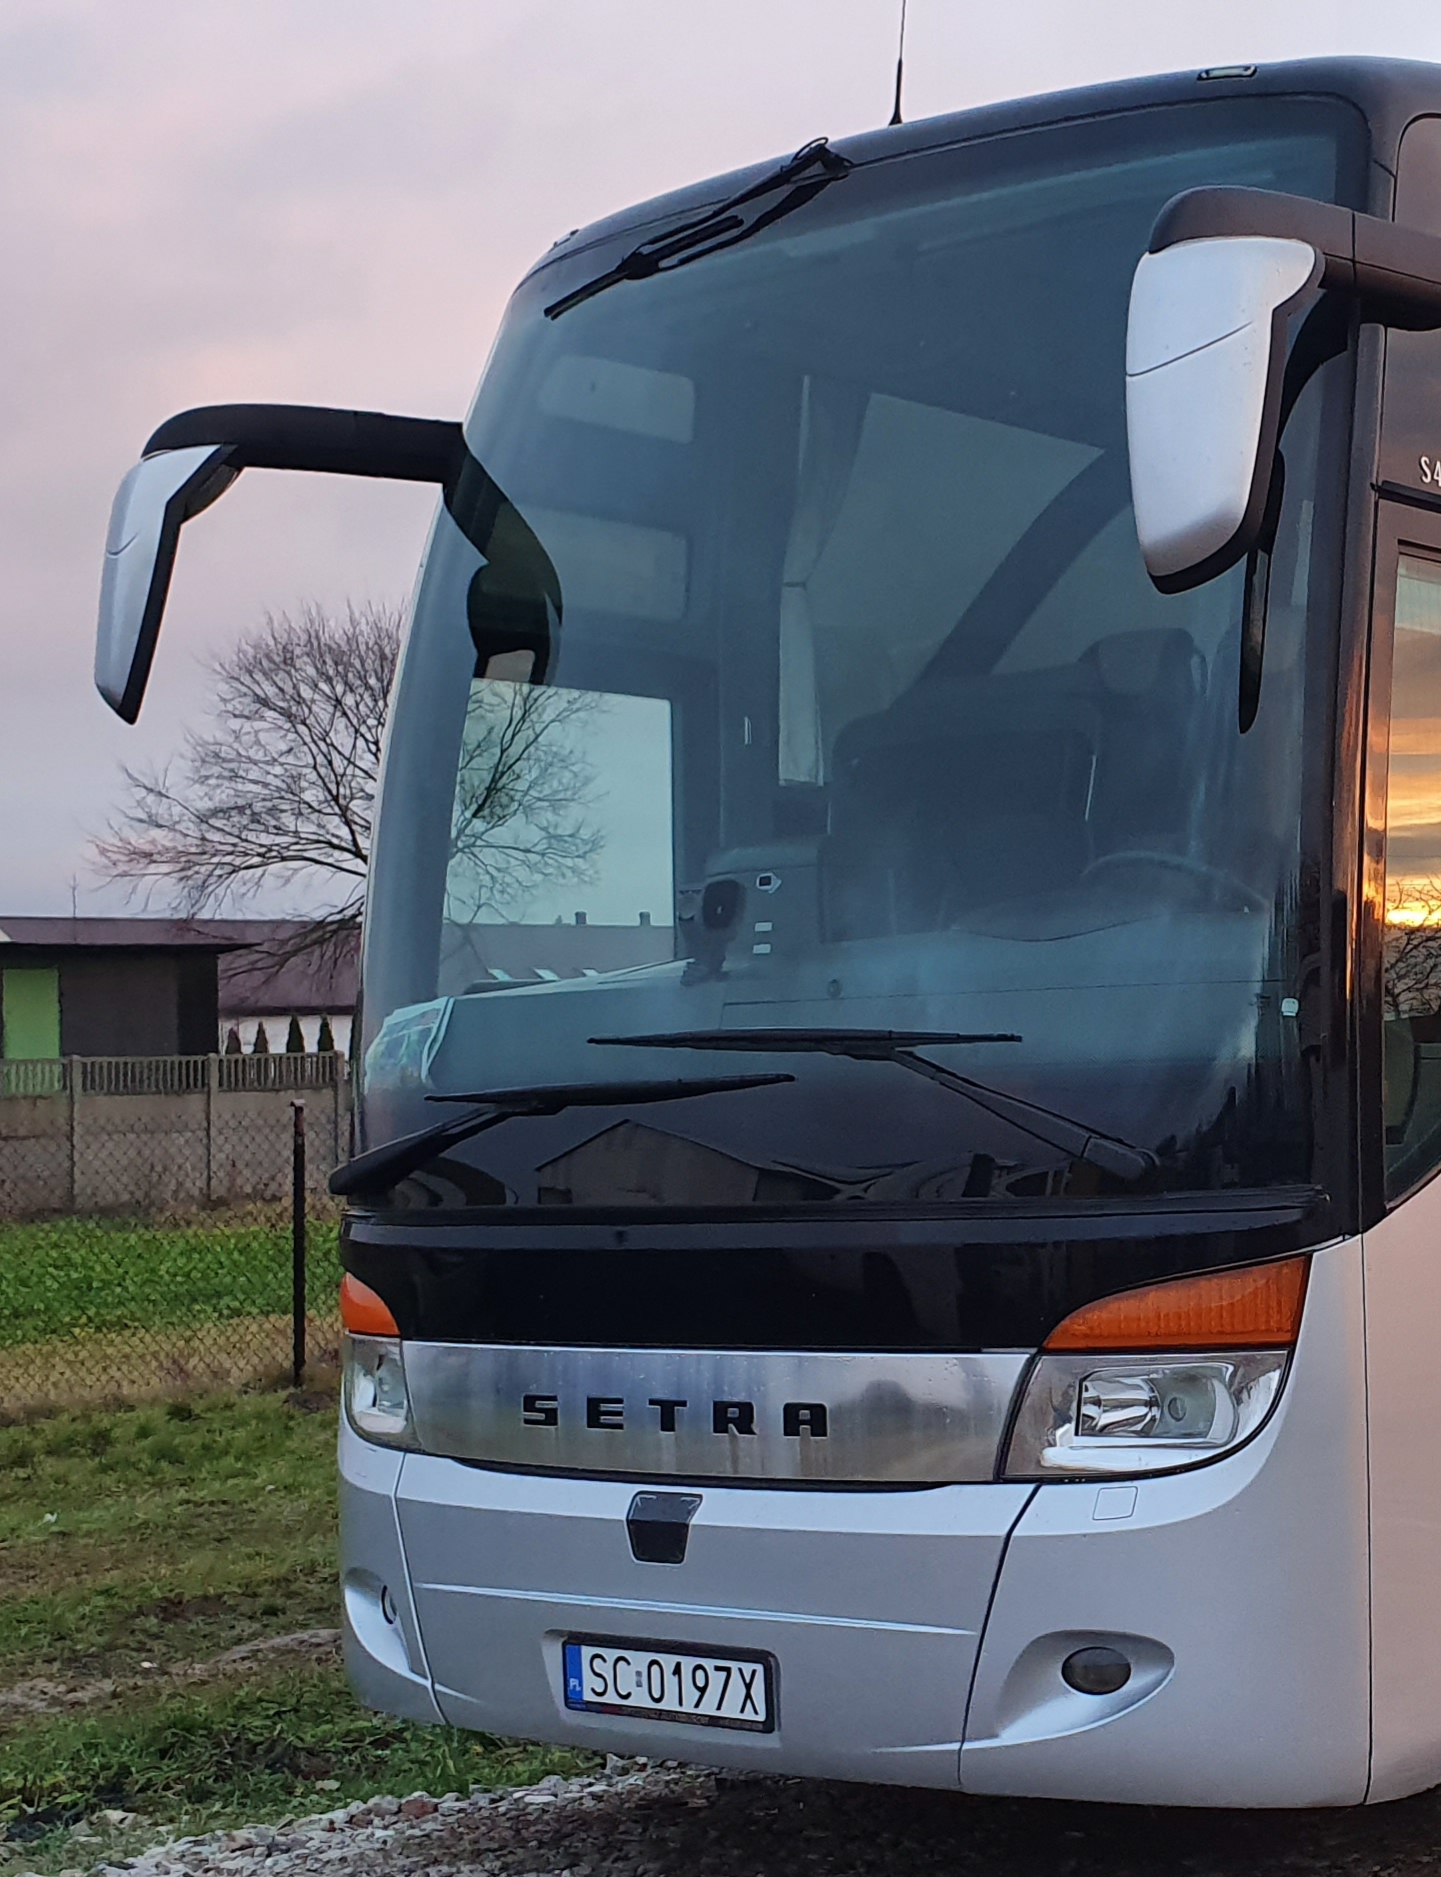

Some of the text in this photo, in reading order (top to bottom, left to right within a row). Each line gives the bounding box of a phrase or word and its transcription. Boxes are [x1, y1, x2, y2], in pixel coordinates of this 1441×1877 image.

[1420, 456, 1432, 484] S
[522, 1394, 828, 1438] SETRA
[569, 1678, 581, 1691] PL
[589, 1653, 759, 1716] SC 0197X
